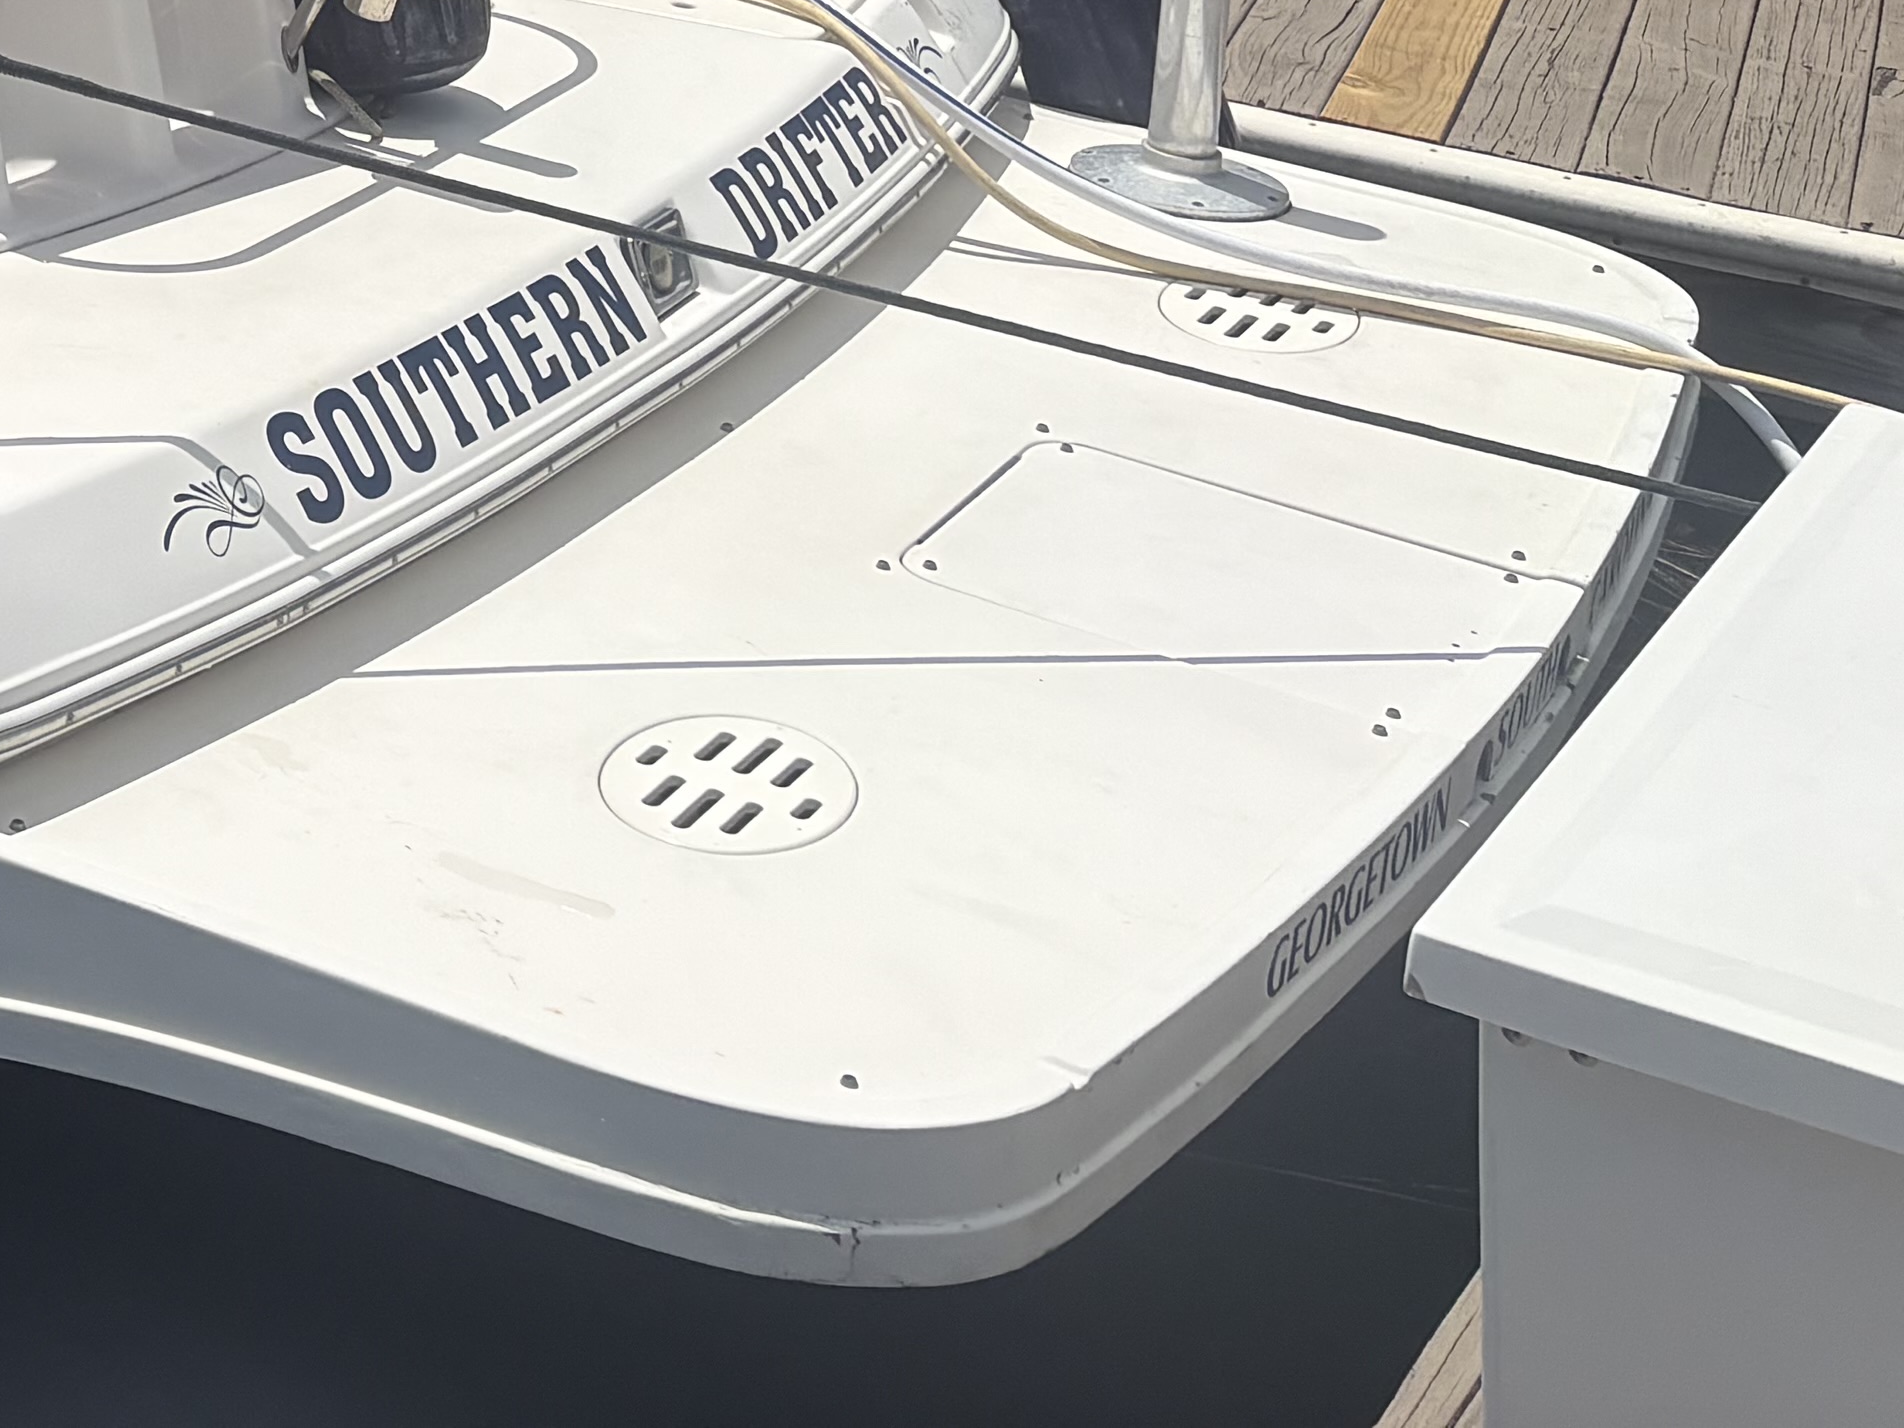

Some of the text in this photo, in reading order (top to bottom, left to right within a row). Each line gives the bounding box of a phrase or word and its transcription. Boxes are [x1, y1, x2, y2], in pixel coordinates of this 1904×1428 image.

[264, 66, 908, 525] SOUTHERN DRIFTER
[1265, 777, 1453, 998] GEORGETOWN
